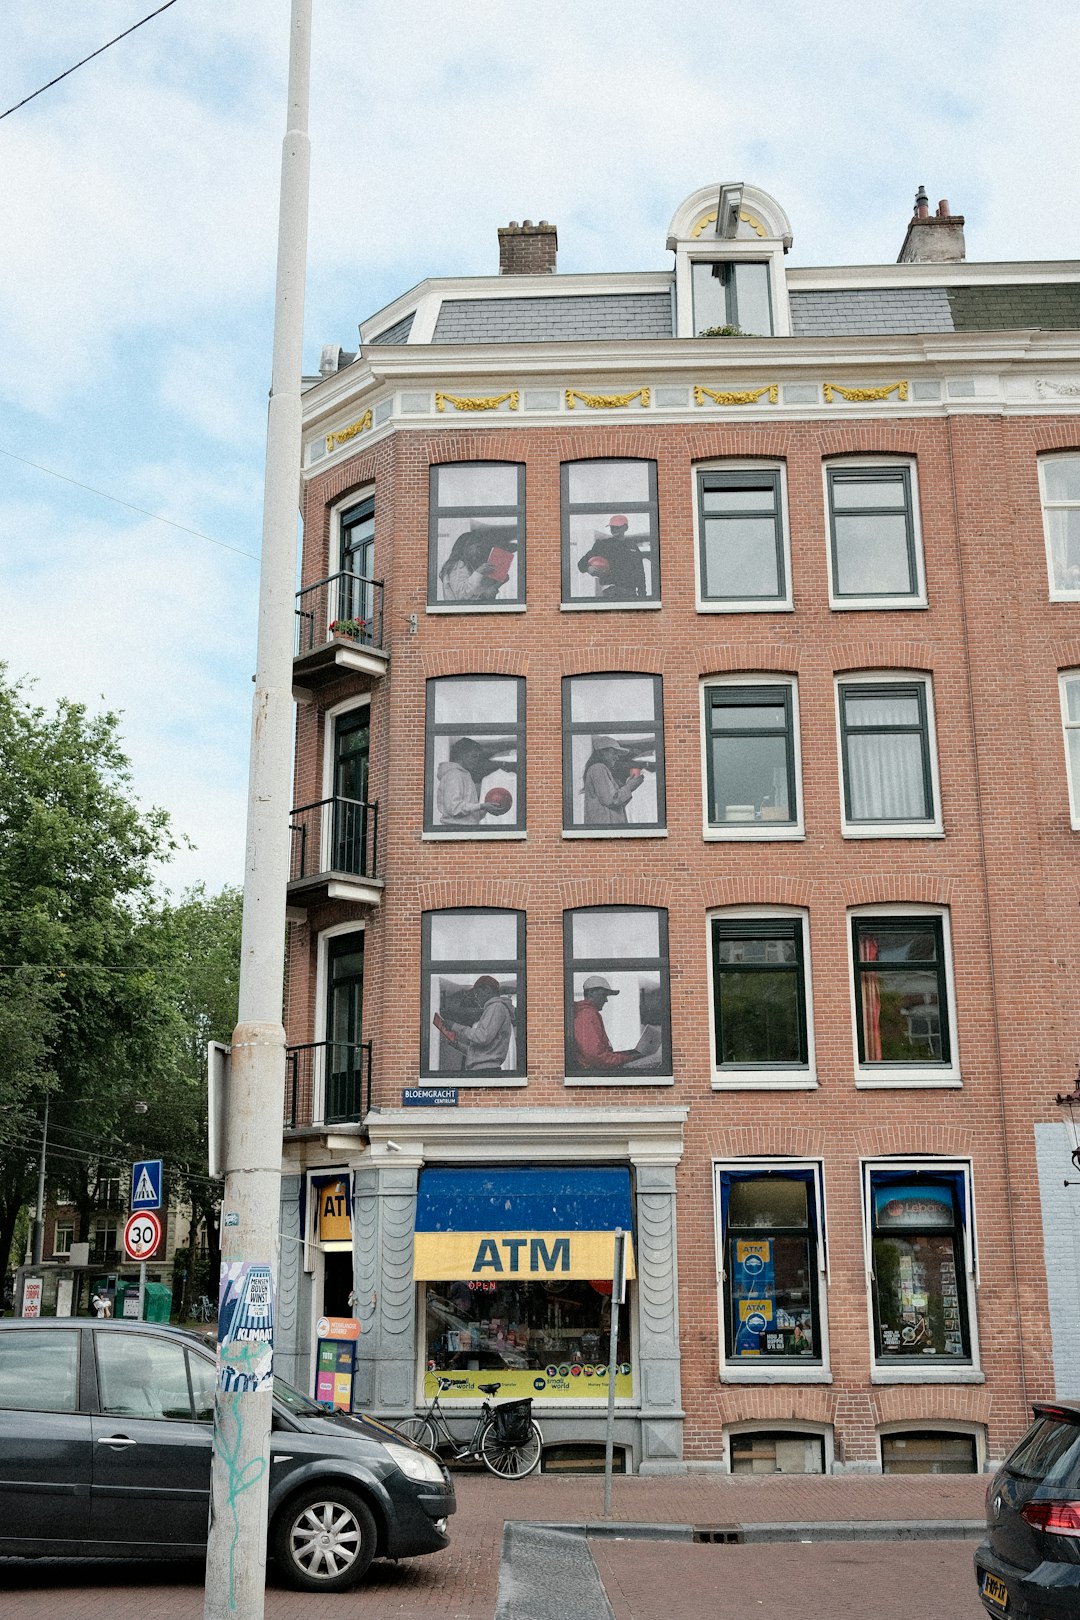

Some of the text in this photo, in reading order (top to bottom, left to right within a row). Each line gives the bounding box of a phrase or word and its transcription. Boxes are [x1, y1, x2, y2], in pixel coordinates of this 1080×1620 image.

[405, 1090, 456, 1098] BLOEMGRACHT
[131, 1226, 154, 1244] 30
[472, 1239, 570, 1272] ATM
[250, 1284, 268, 1293] BOVEN
[468, 1281, 497, 1290] OPEN
[250, 1292, 268, 1303] WINST
[237, 1328, 272, 1341] KLIMAAT
